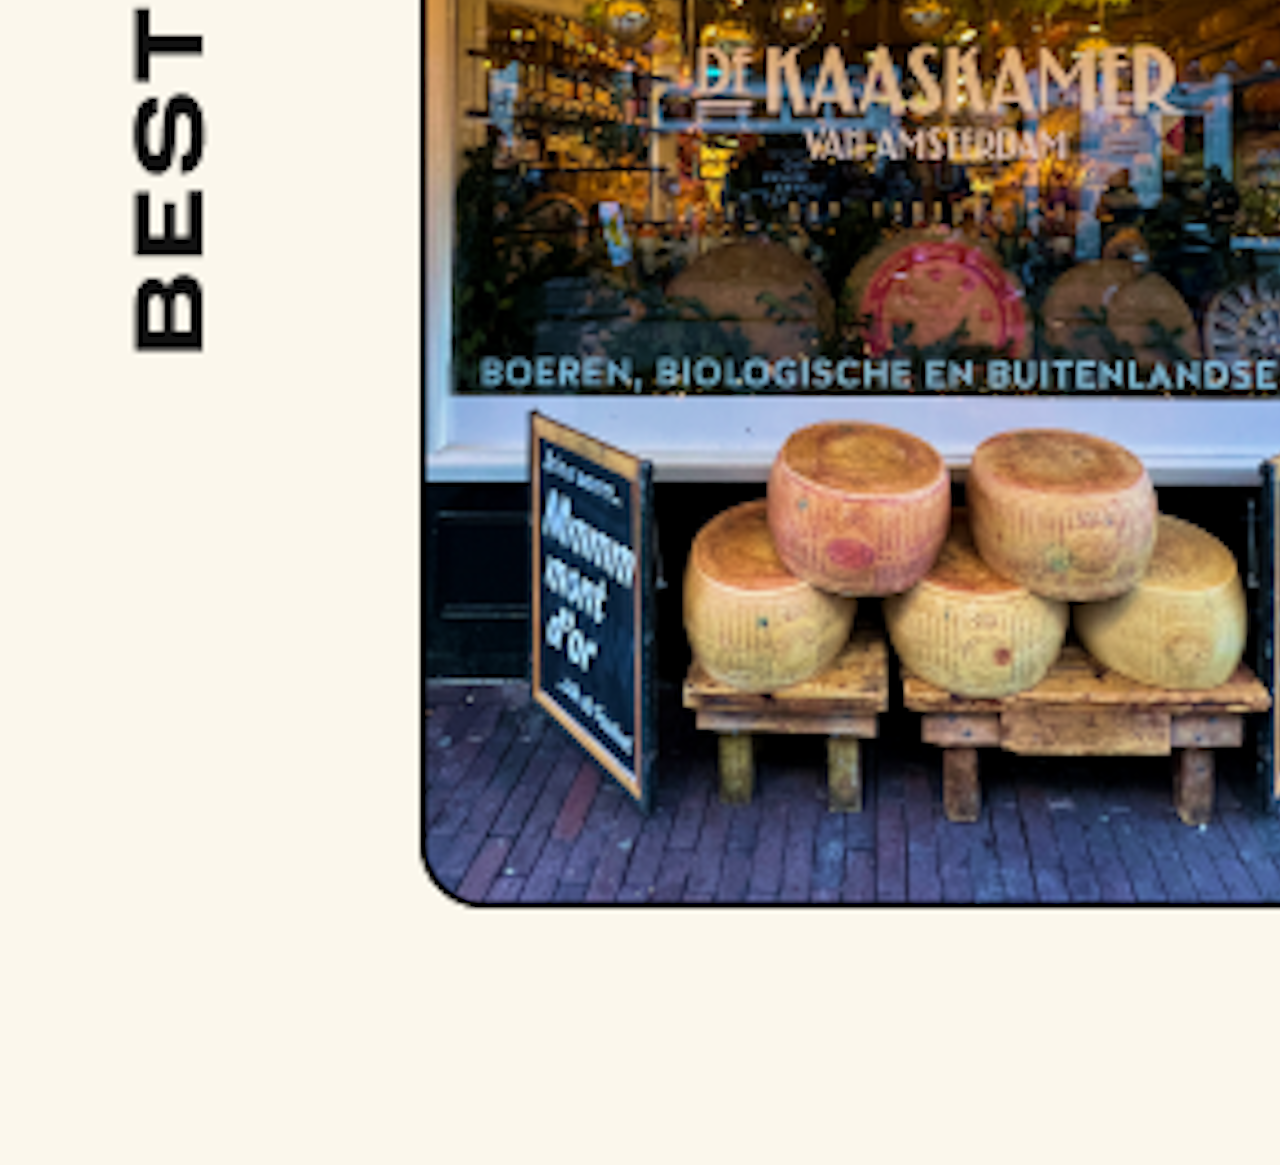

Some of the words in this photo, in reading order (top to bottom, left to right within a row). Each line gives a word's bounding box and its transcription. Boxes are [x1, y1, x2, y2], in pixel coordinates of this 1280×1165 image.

[700, 47, 753, 96] DE
[766, 44, 1182, 116] KAASKAMER
[804, 127, 866, 161] VAN
[876, 127, 1068, 161] AMSTERDAM
[480, 355, 642, 393] BOEREN,
[655, 355, 912, 390] BIOLOGISCHE
[925, 359, 973, 390] EN
[987, 359, 1277, 391] BUITENLANDSE
